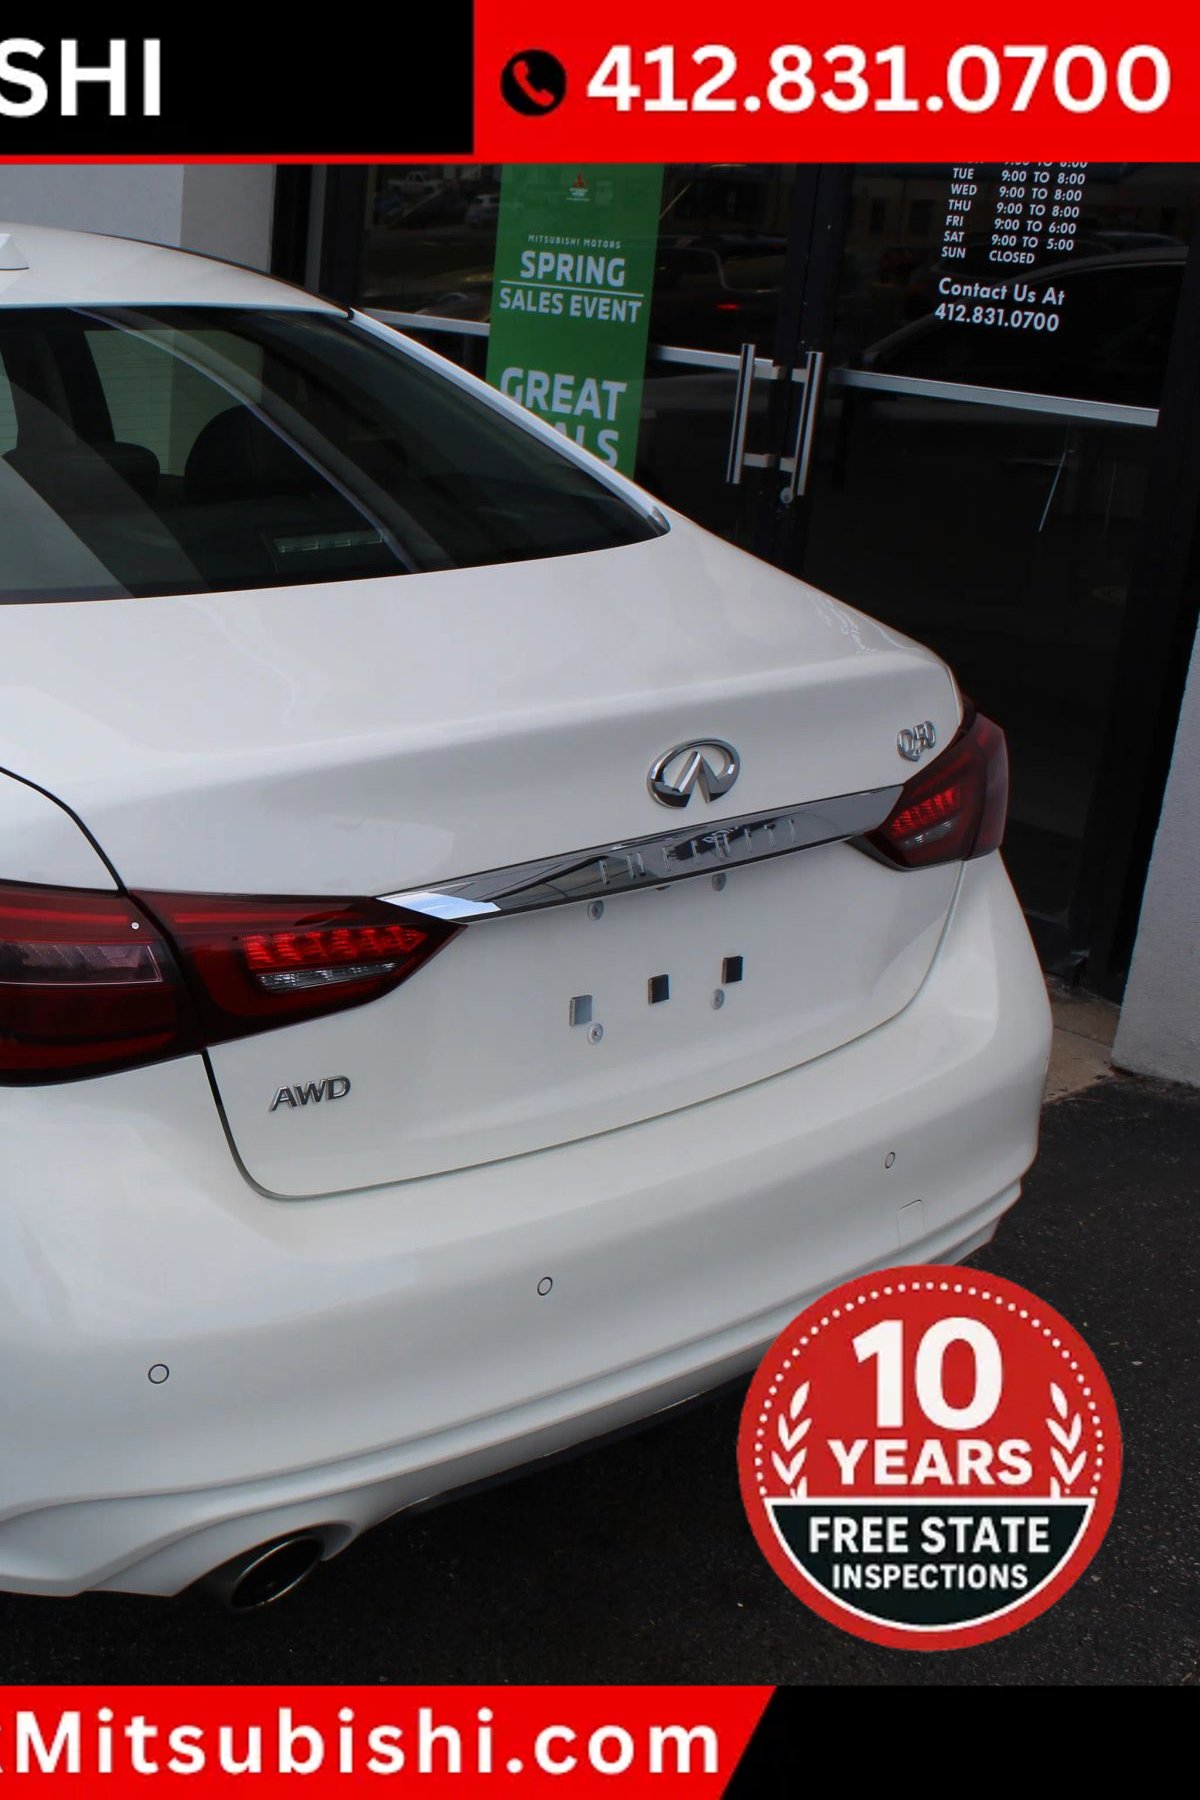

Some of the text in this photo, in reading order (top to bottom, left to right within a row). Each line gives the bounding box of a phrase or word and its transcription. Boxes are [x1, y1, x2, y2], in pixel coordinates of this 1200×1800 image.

[953, 167, 1086, 185] TUE 9:00 TO 8:00
[951, 184, 1082, 201] WED 9:00 TO 8:00
[948, 199, 1080, 218] THU 9:00 TO 8:00
[945, 215, 1076, 235] FRI 9:00 TO 6:00
[527, 234, 622, 250] MITSUBISHI MOTORS
[943, 230, 1074, 251] SAT 9:00 TO 5:00
[941, 246, 1035, 264] SUN CLOSED
[519, 250, 626, 288] SPRING
[938, 277, 1065, 306] Contact Us At
[499, 287, 642, 323] SALES EVENT
[934, 303, 1060, 332] 412.831.0700
[500, 366, 628, 422] GREAT
[268, 1075, 351, 1112] AWD
